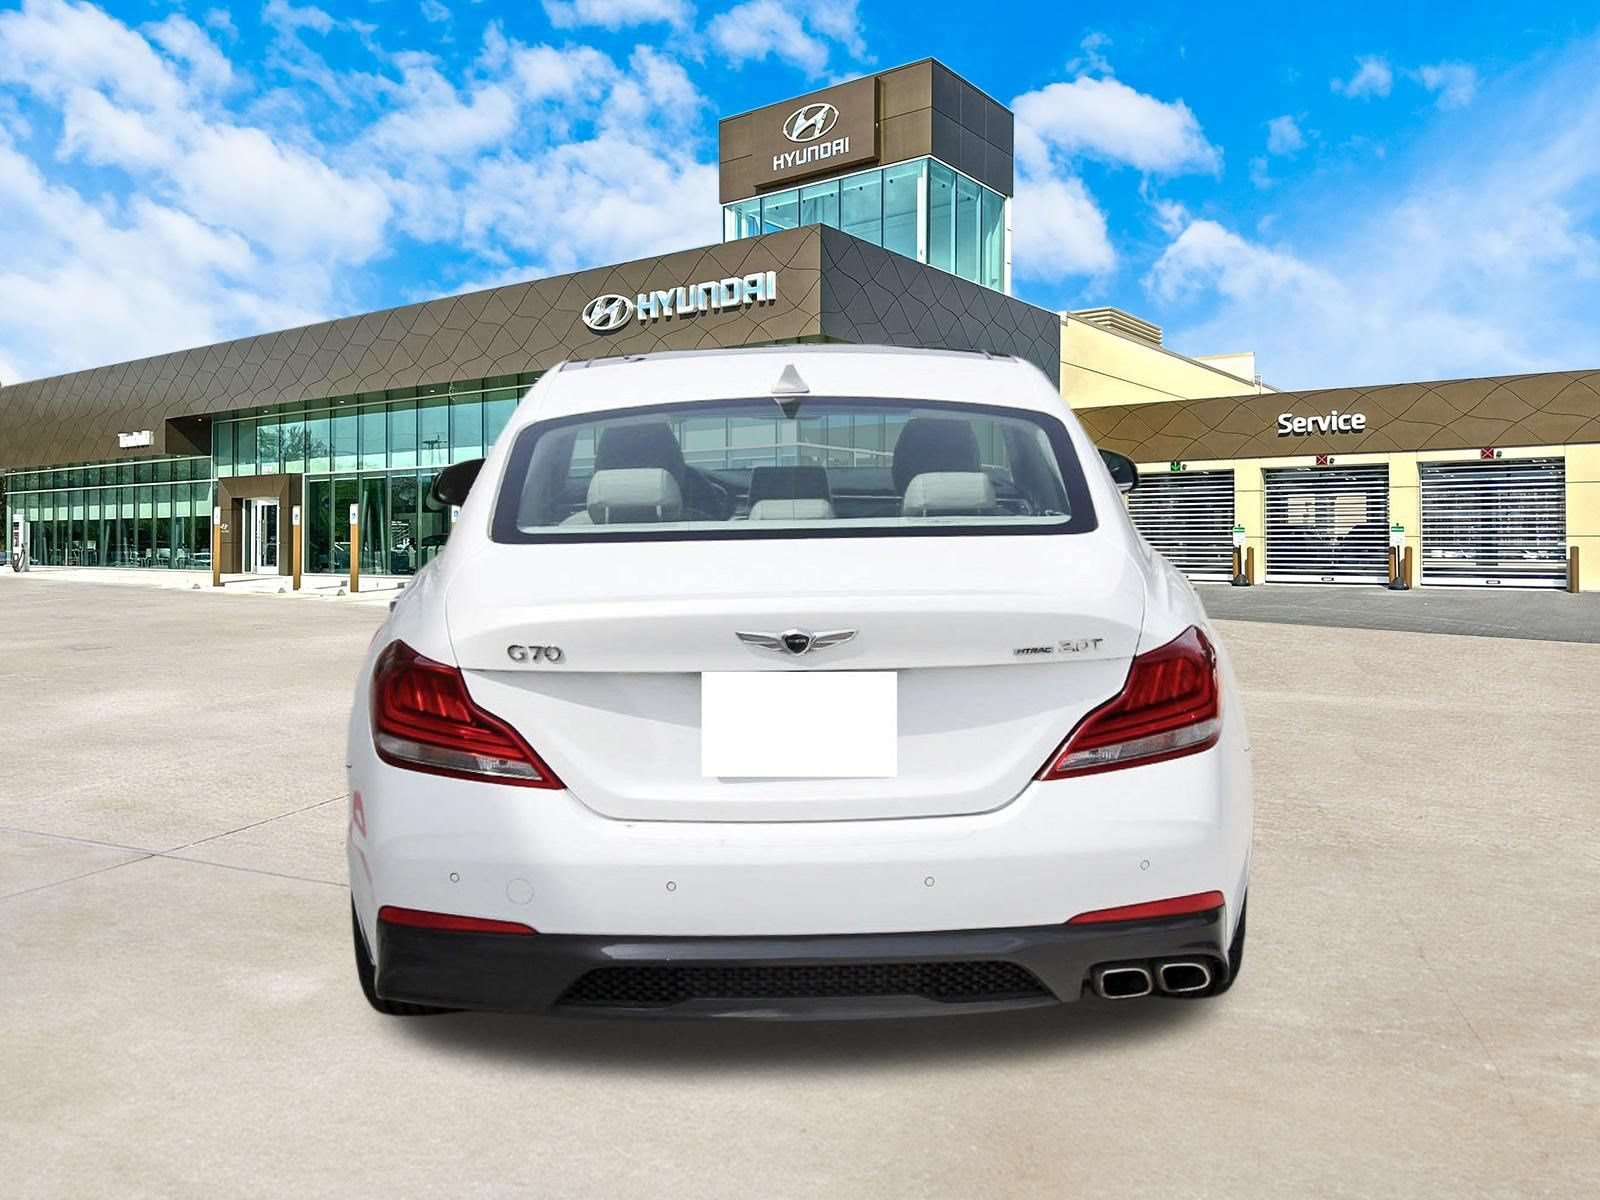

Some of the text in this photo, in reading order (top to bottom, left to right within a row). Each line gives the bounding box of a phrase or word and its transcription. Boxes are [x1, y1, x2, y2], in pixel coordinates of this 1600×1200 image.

[773, 137, 849, 171] HYUNDAI
[636, 271, 777, 321] HYUNDAI
[1277, 410, 1366, 434] Service
[507, 644, 564, 663] G70
